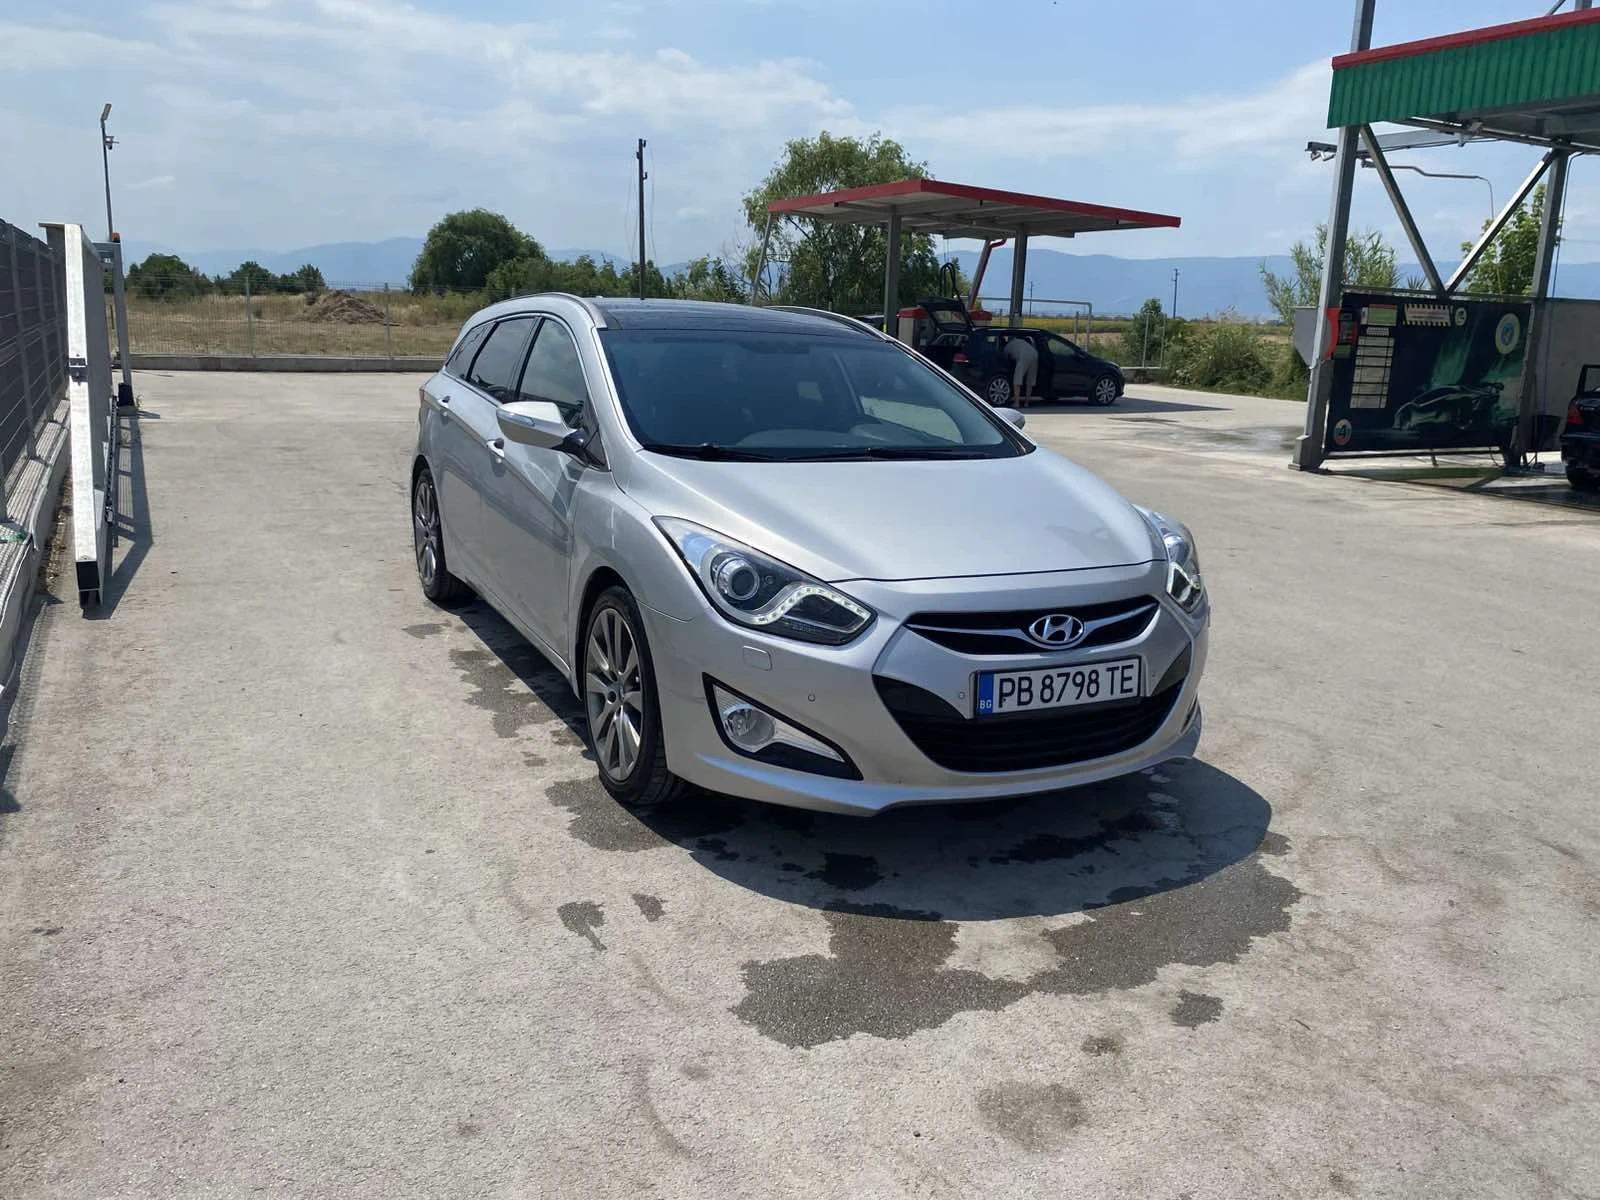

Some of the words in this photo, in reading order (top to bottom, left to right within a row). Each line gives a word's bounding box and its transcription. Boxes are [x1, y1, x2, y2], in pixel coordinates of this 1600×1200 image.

[998, 676, 1034, 708] PB
[1040, 670, 1100, 703] 8798
[1106, 664, 1134, 695] TE
[979, 699, 992, 709] BG
